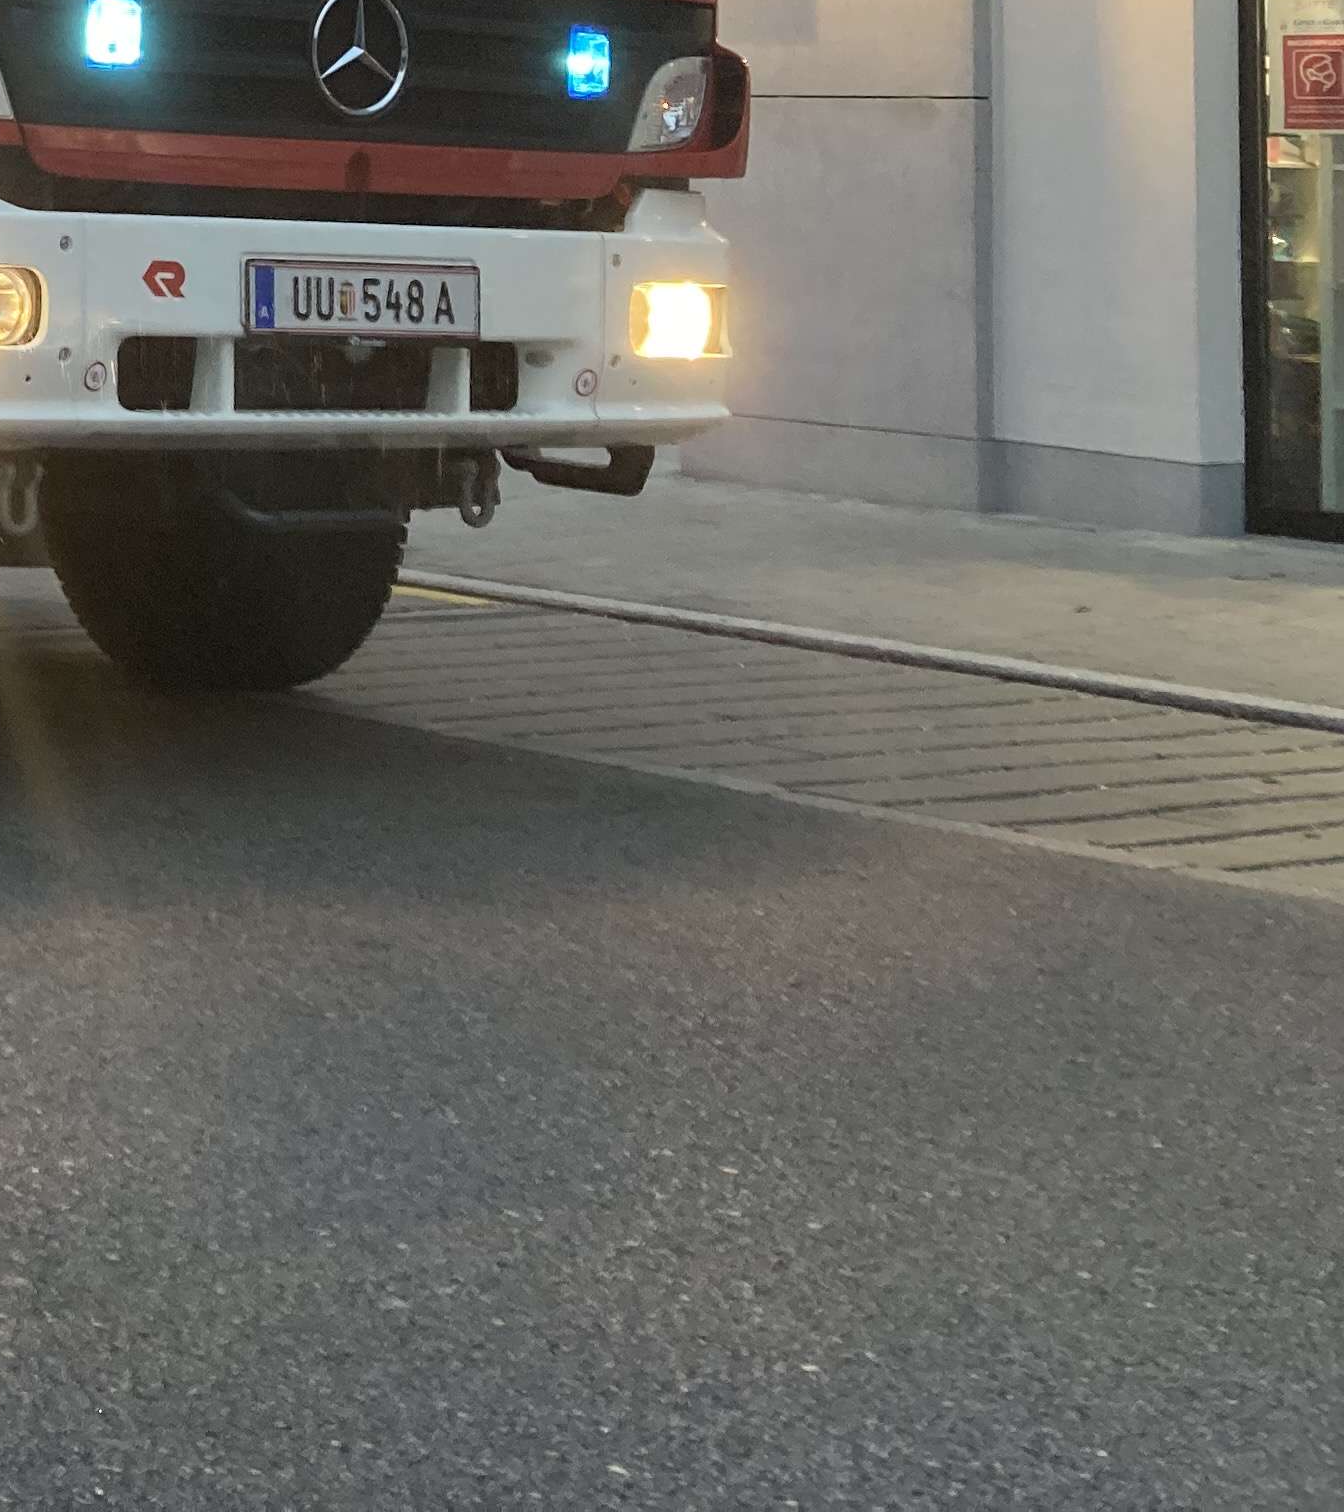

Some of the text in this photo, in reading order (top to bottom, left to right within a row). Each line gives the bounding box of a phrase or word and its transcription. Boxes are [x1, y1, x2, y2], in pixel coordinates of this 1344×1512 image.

[293, 275, 335, 322] UU
[362, 278, 425, 325] 548
[435, 281, 456, 325] A
